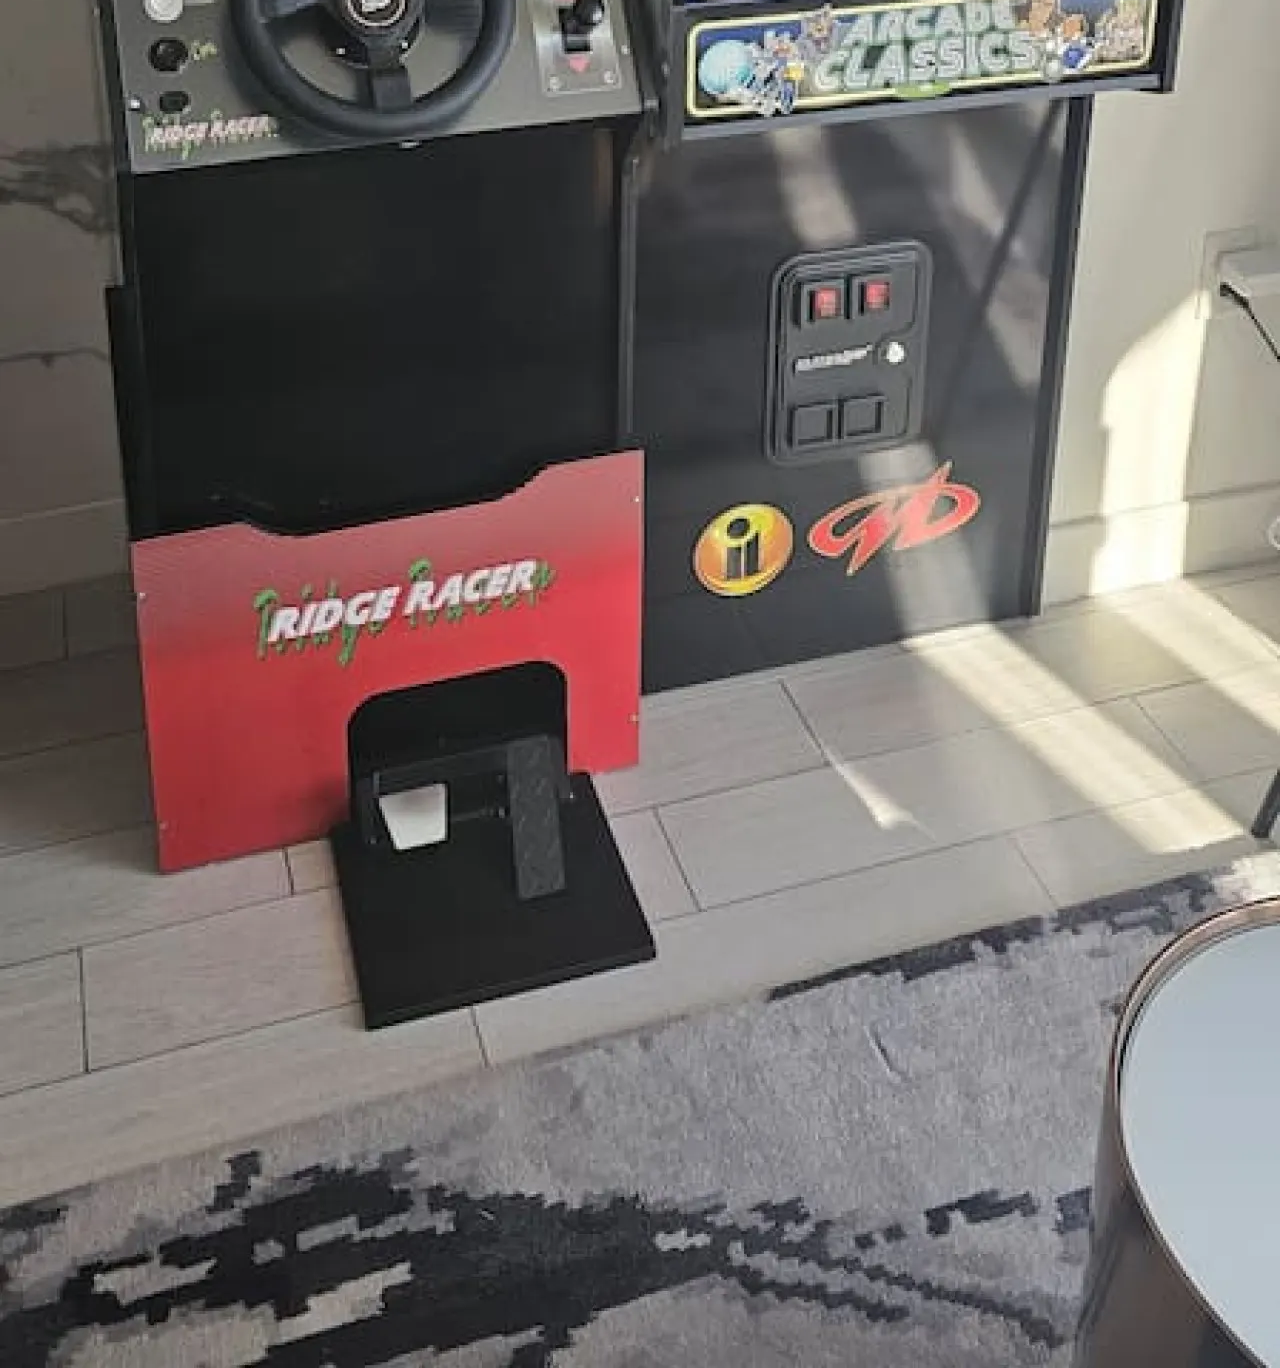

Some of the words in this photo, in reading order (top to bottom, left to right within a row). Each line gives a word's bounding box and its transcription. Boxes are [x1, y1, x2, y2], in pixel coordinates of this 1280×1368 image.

[813, 32, 1041, 93] CLASSICS
[267, 585, 400, 642] RIDGE
[403, 558, 538, 615] RACER
